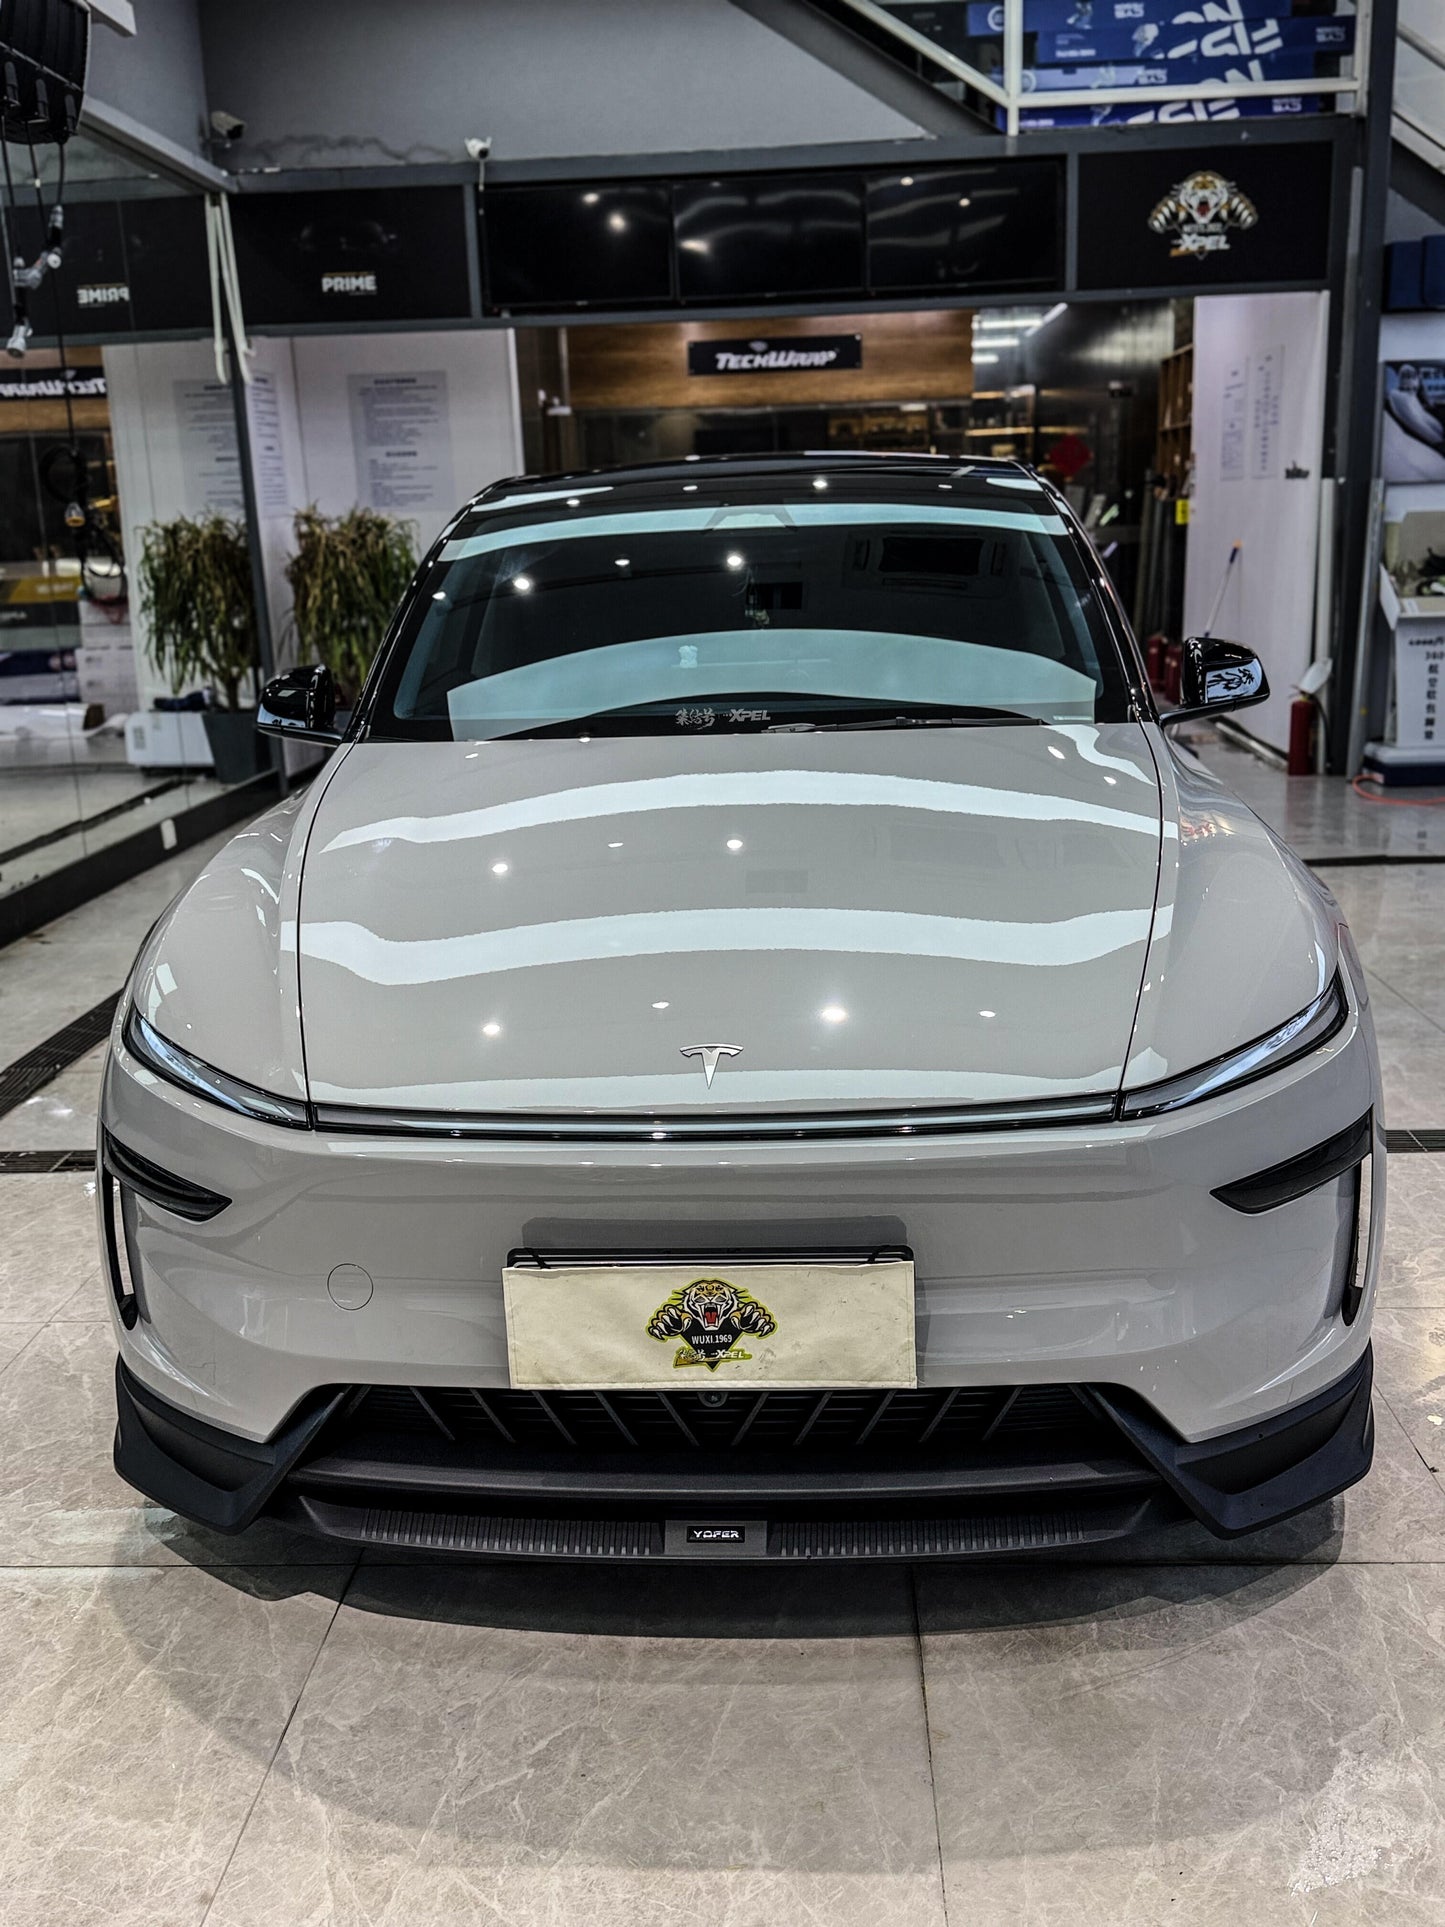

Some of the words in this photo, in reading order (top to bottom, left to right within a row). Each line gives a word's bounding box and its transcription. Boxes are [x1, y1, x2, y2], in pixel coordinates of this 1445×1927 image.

[321, 275, 377, 292] PRIME
[728, 708, 771, 723] XPEL
[691, 1334, 733, 1345] WUXI.1969
[716, 1349, 744, 1359] XPEL
[693, 1530, 740, 1539] YOFER
